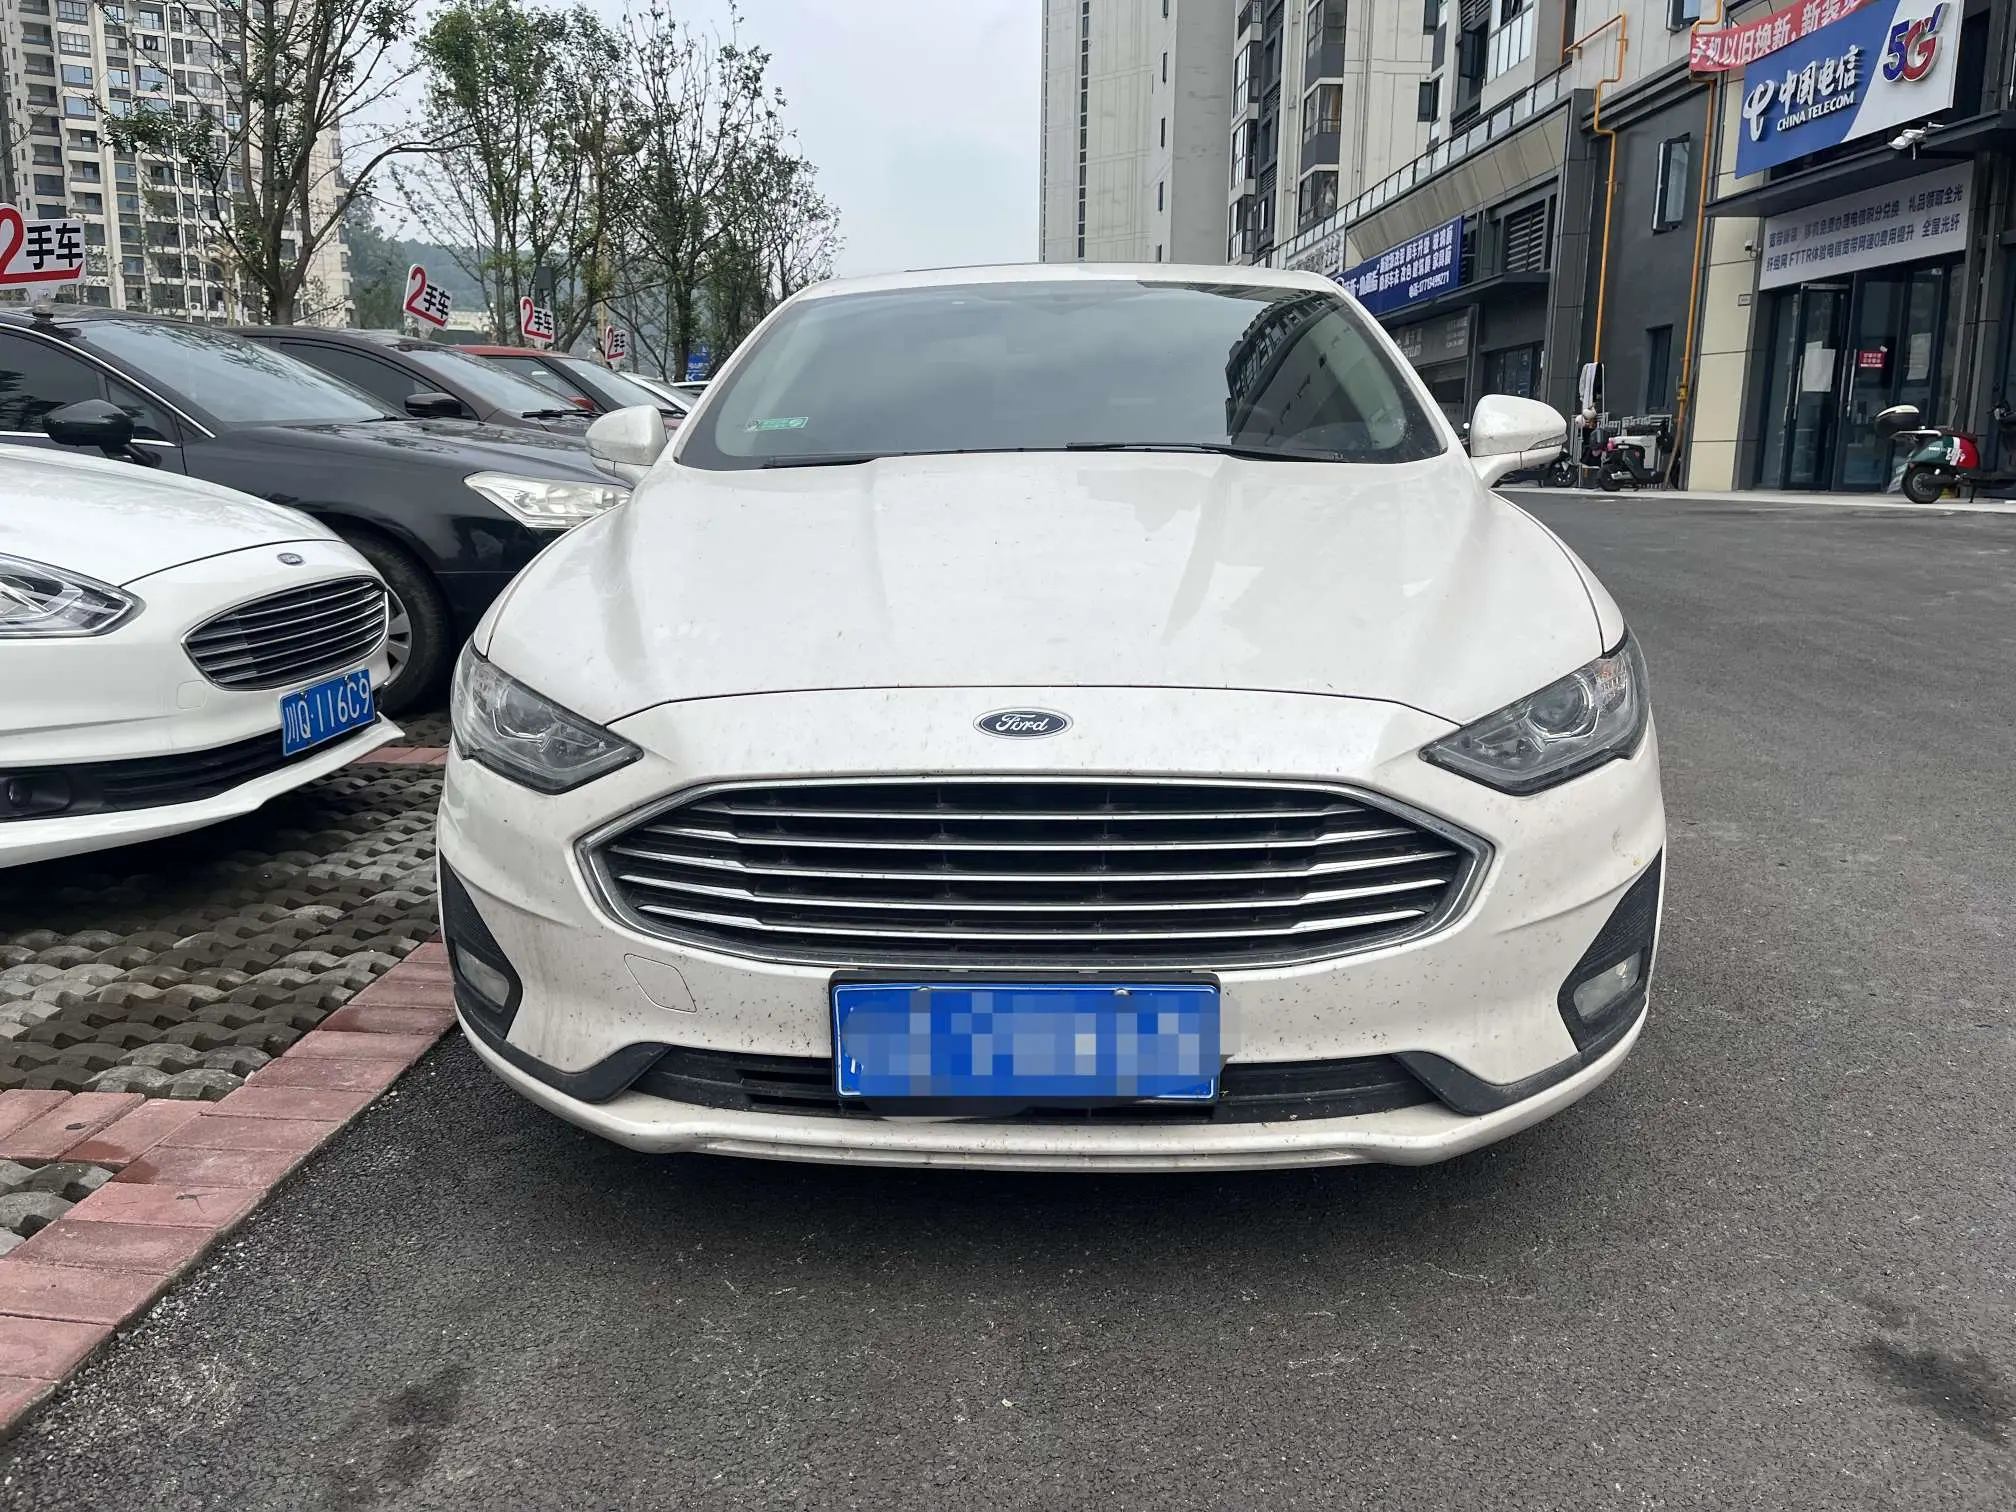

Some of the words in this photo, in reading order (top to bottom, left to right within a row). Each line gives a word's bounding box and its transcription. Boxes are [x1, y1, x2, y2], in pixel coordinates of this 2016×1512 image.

[1882, 3, 1944, 82] 5G
[1778, 44, 1859, 114] 中国电信
[1776, 109, 1806, 131] CHINA
[1807, 92, 1855, 119] TELECOM
[0, 207, 83, 284] 2手车
[405, 266, 449, 327] 2手车
[522, 299, 552, 340] 2手车
[285, 678, 370, 744] 川Q·116C9
[996, 713, 1049, 731] Ford
